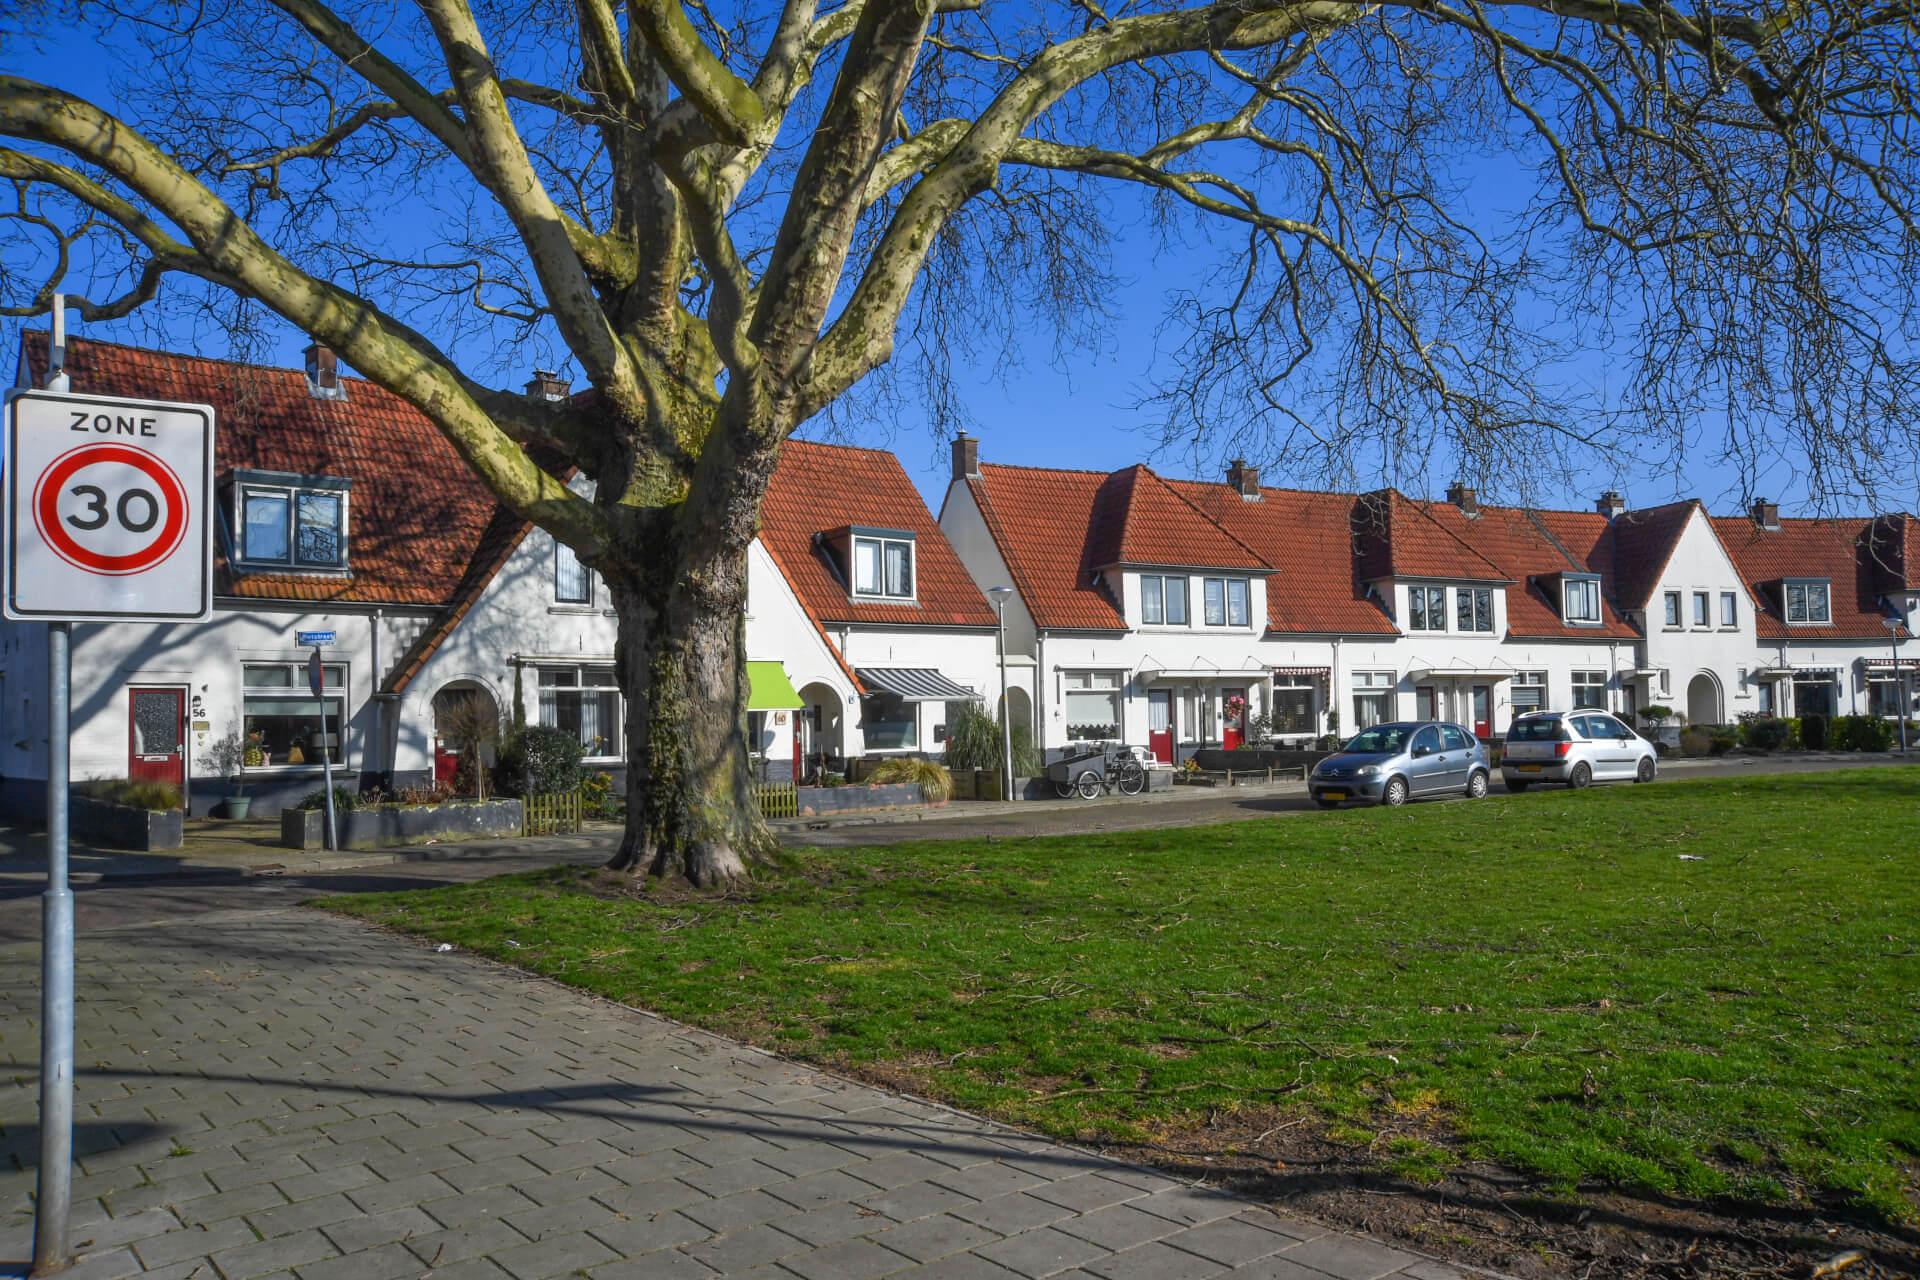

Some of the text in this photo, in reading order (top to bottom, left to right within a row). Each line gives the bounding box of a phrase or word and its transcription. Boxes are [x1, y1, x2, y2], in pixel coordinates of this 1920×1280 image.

[70, 411, 157, 437] ZONE
[66, 484, 159, 533] 30
[193, 709, 206, 717] 56
